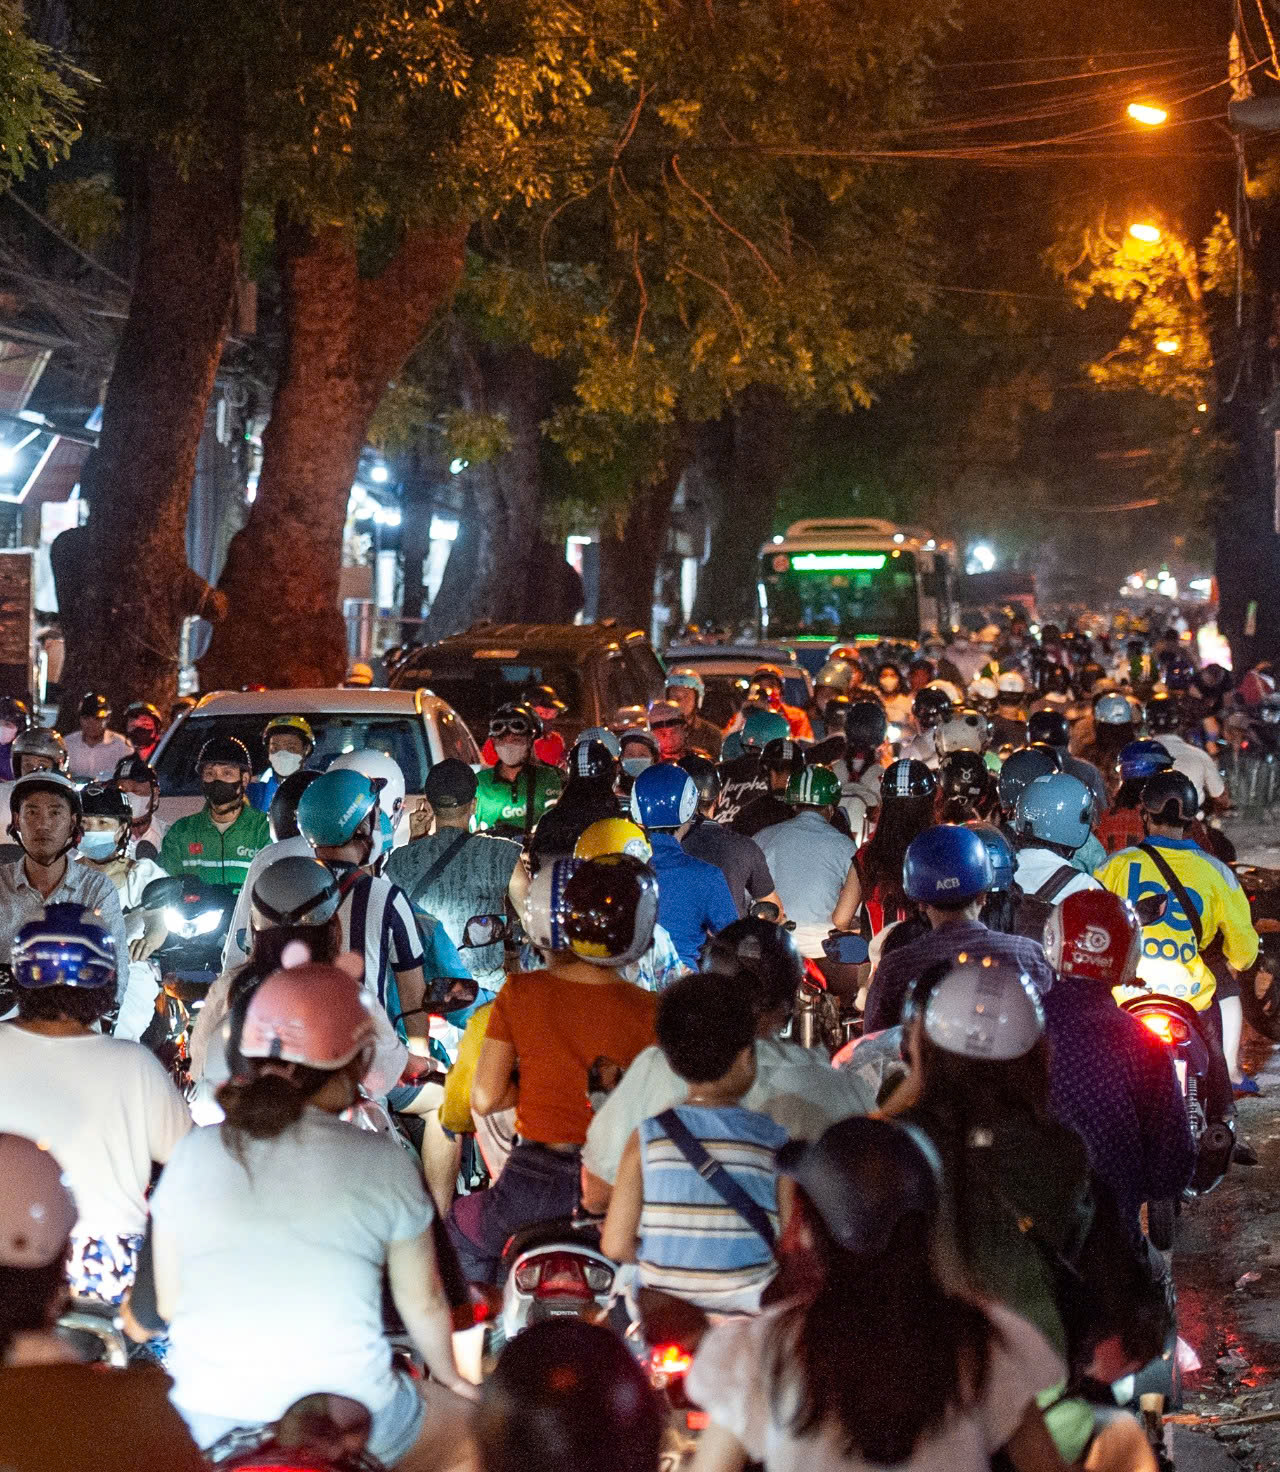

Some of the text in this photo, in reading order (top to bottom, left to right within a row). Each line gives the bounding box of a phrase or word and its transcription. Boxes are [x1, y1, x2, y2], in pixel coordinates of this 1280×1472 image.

[237, 845, 260, 858] Gra
[936, 878, 960, 890] ACB
[1144, 927, 1197, 964] ood
